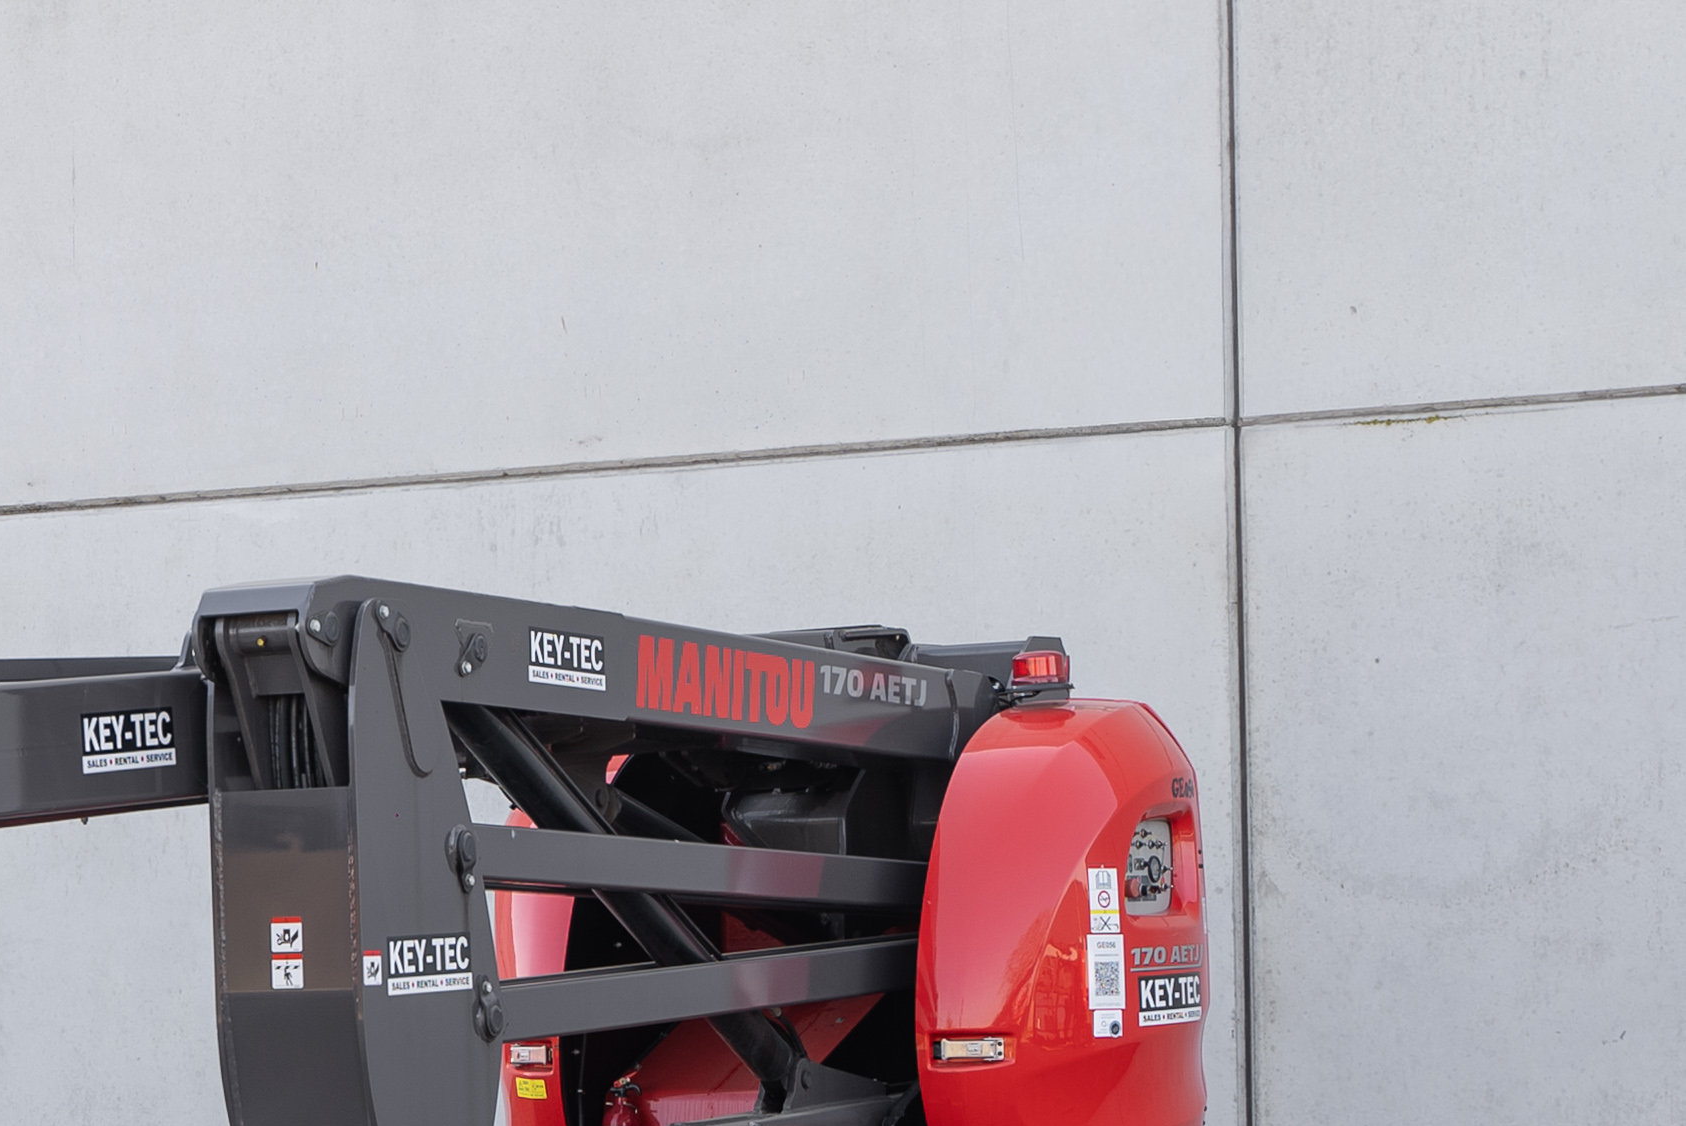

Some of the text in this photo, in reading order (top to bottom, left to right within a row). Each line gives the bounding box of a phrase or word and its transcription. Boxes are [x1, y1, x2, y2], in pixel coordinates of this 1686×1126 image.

[530, 630, 603, 672] KEY-TEC
[532, 669, 604, 687] SALES RENTAL SERVICE
[636, 634, 815, 729] MANITOU
[820, 665, 927, 707] 170 AETJ
[83, 711, 173, 752] KEY-TEC
[87, 752, 173, 769] SALES RENTAL SERVICE
[389, 936, 470, 975] KEY-TEC
[1131, 944, 1199, 966] 170 AETJ
[392, 976, 470, 991] SALES RENTAL SERVICE
[1140, 975, 1201, 1009] KEY-TEC
[1143, 1013, 1161, 1022] SALES
